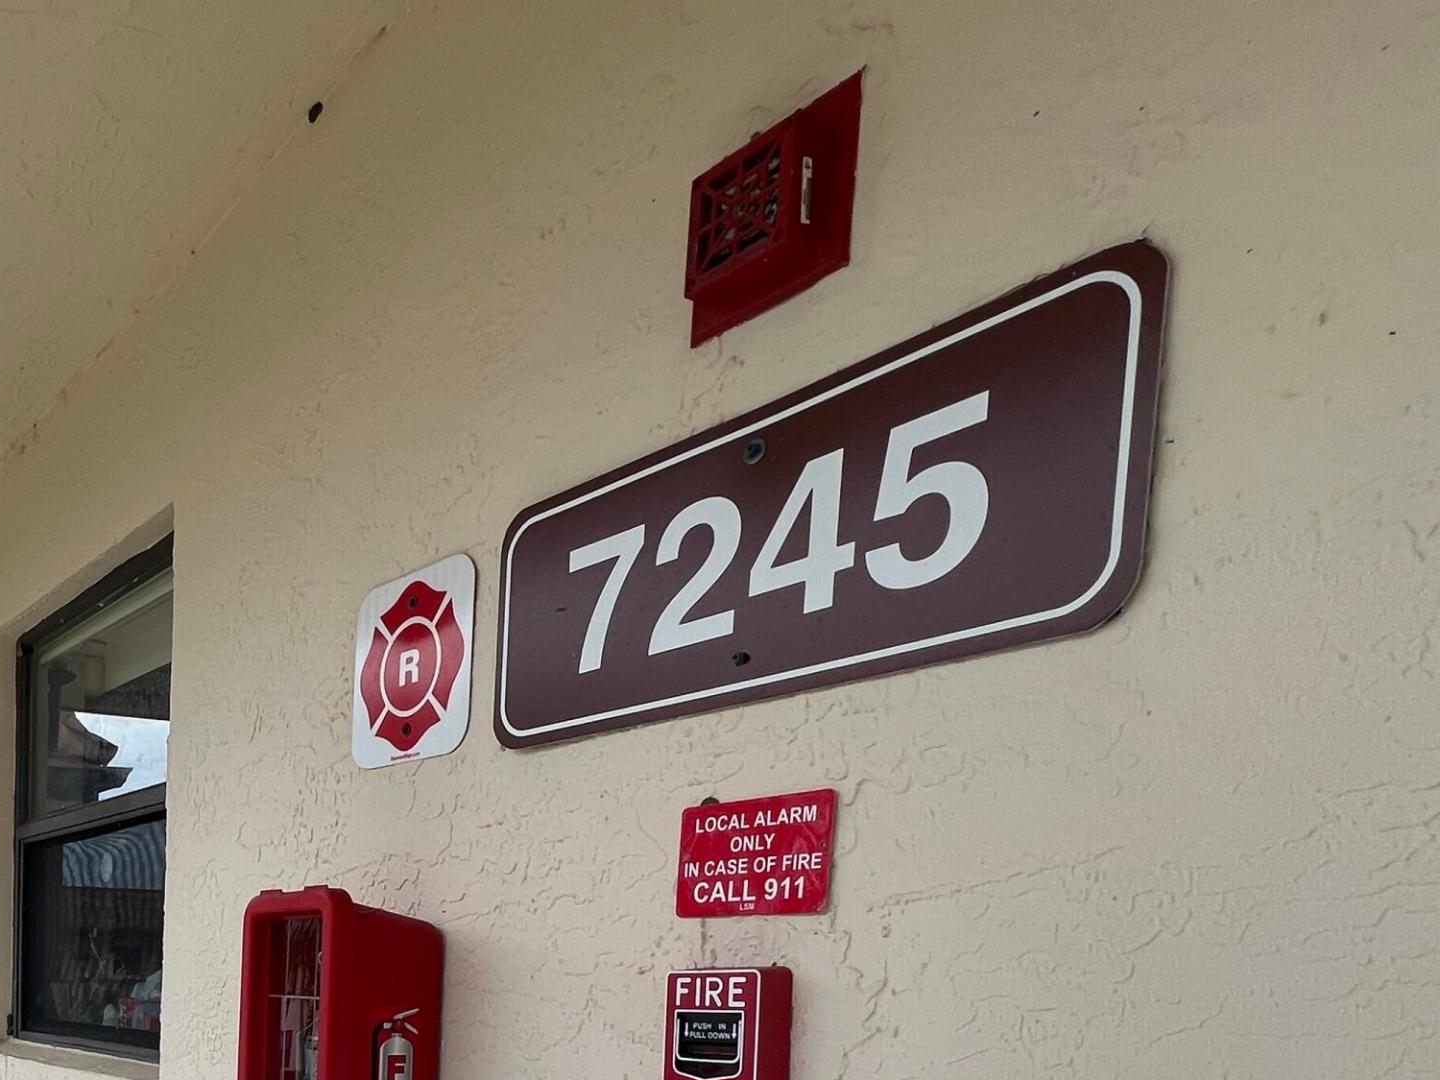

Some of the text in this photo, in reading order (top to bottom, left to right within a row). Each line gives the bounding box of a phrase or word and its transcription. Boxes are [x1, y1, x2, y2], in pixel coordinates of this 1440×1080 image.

[569, 390, 990, 675] 7245
[398, 649, 420, 687] R
[695, 805, 817, 833] LOCAL ALARM
[730, 833, 775, 852] ONLY
[684, 853, 823, 878] IN CASE OF FIRE
[693, 876, 805, 904] CALL 911
[675, 977, 747, 1008] FIRE
[689, 1031, 731, 1040] PULL DOWN
[693, 1022, 727, 1031] PUSH IN
